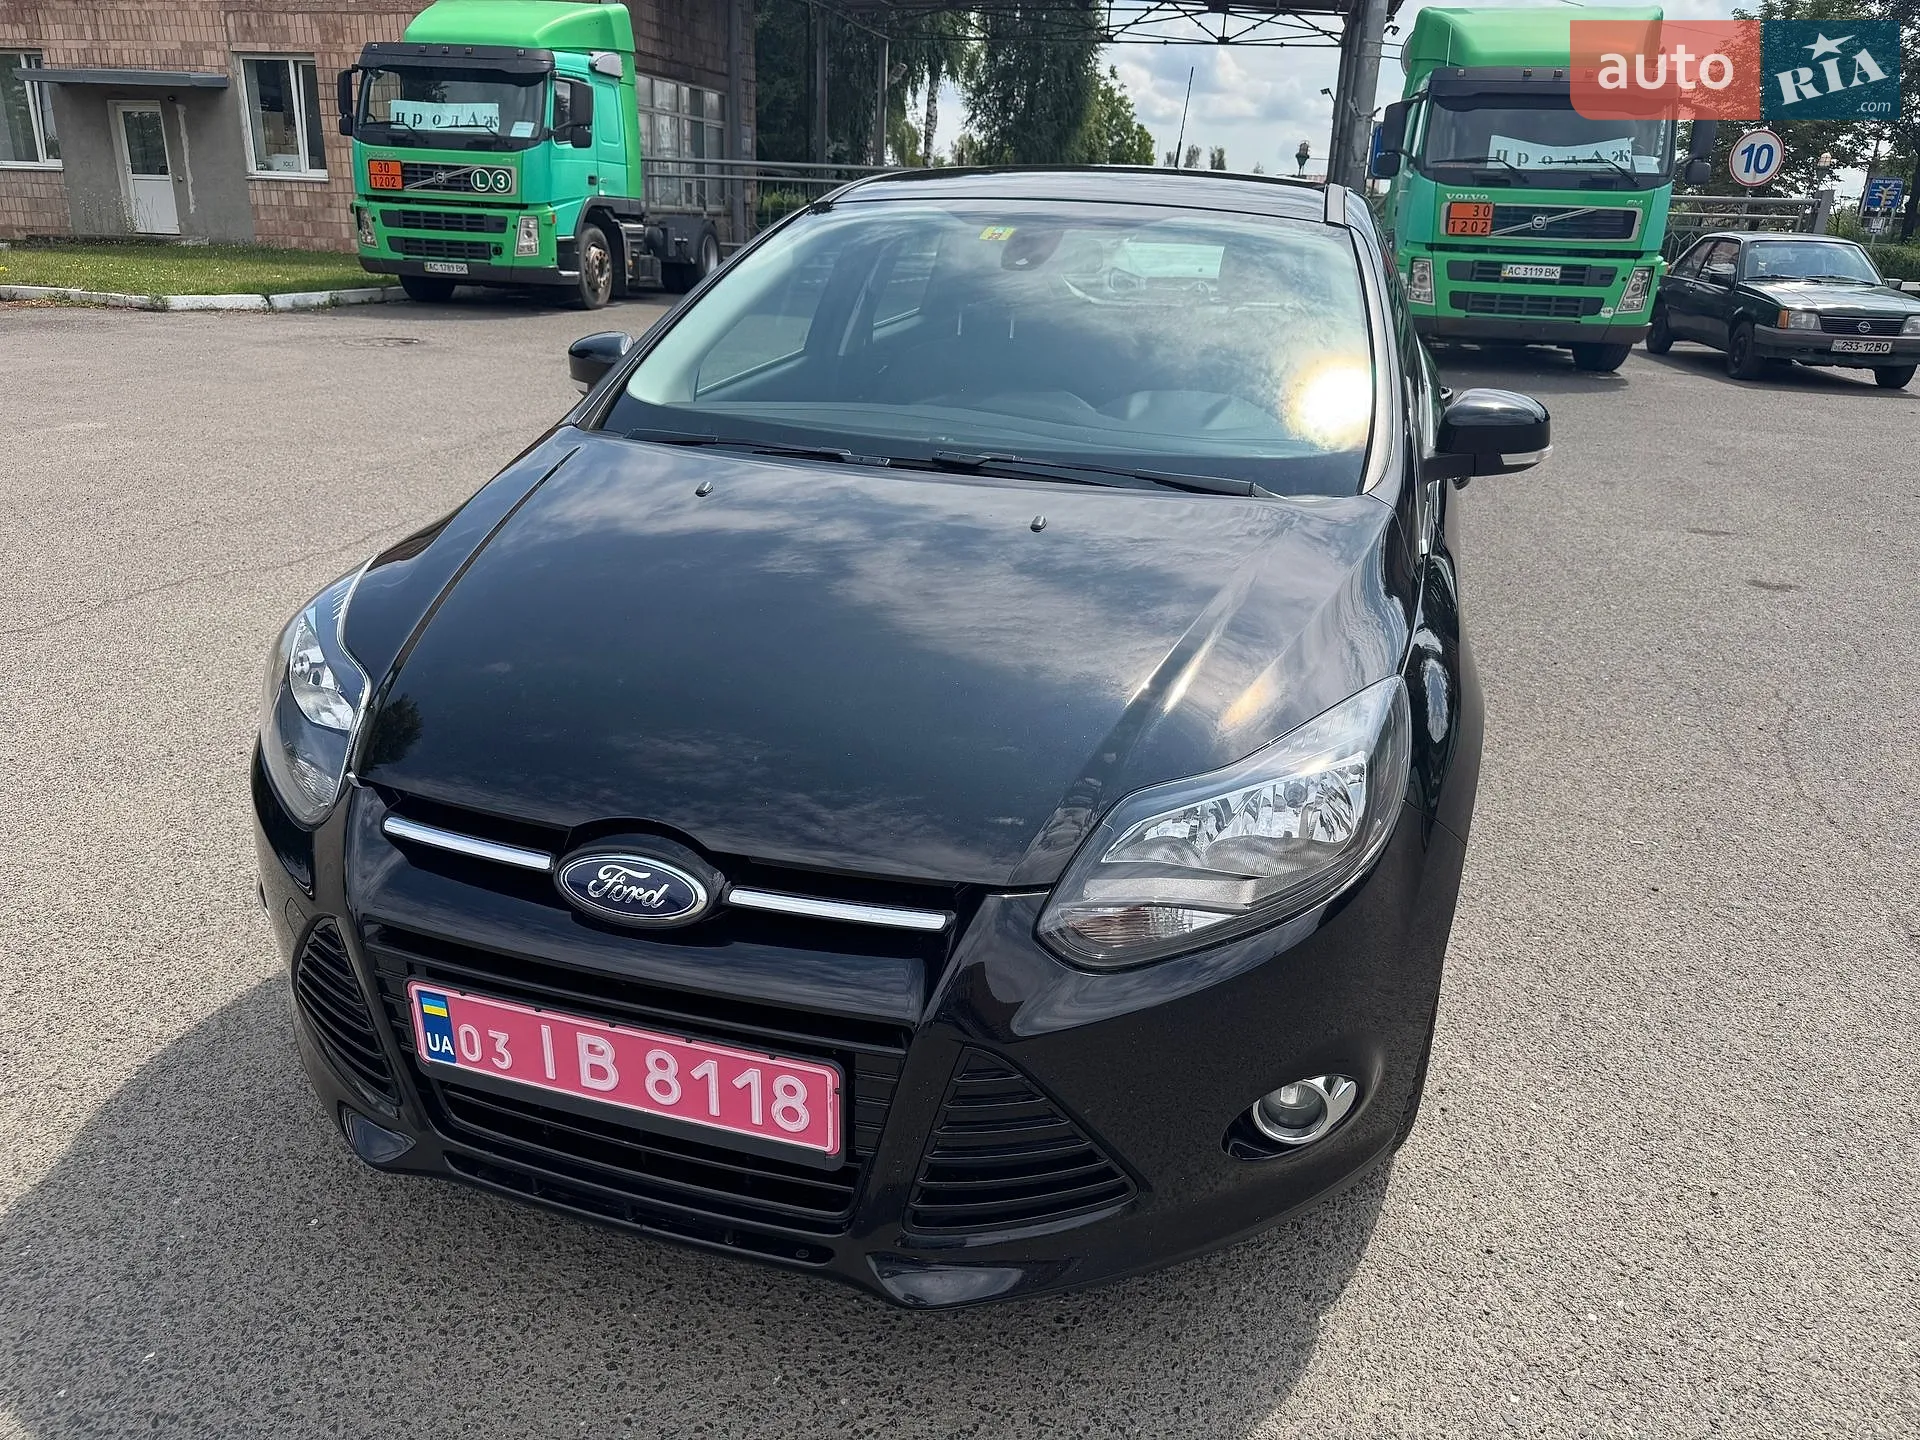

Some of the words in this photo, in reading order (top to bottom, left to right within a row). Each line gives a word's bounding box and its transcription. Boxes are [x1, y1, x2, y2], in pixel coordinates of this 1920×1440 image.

[1740, 143, 1774, 175] 10
[378, 162, 390, 173] 30
[373, 176, 397, 188] 1202
[476, 173, 486, 188] L
[496, 175, 505, 189] 3
[1473, 205, 1490, 217] 30
[1451, 220, 1488, 233] 1202
[1508, 267, 1521, 275] AC
[1522, 267, 1544, 276] 3119
[588, 864, 669, 909] Ford
[426, 1032, 454, 1056] UA
[458, 1023, 513, 1070] 03
[644, 1048, 810, 1133] 8118
